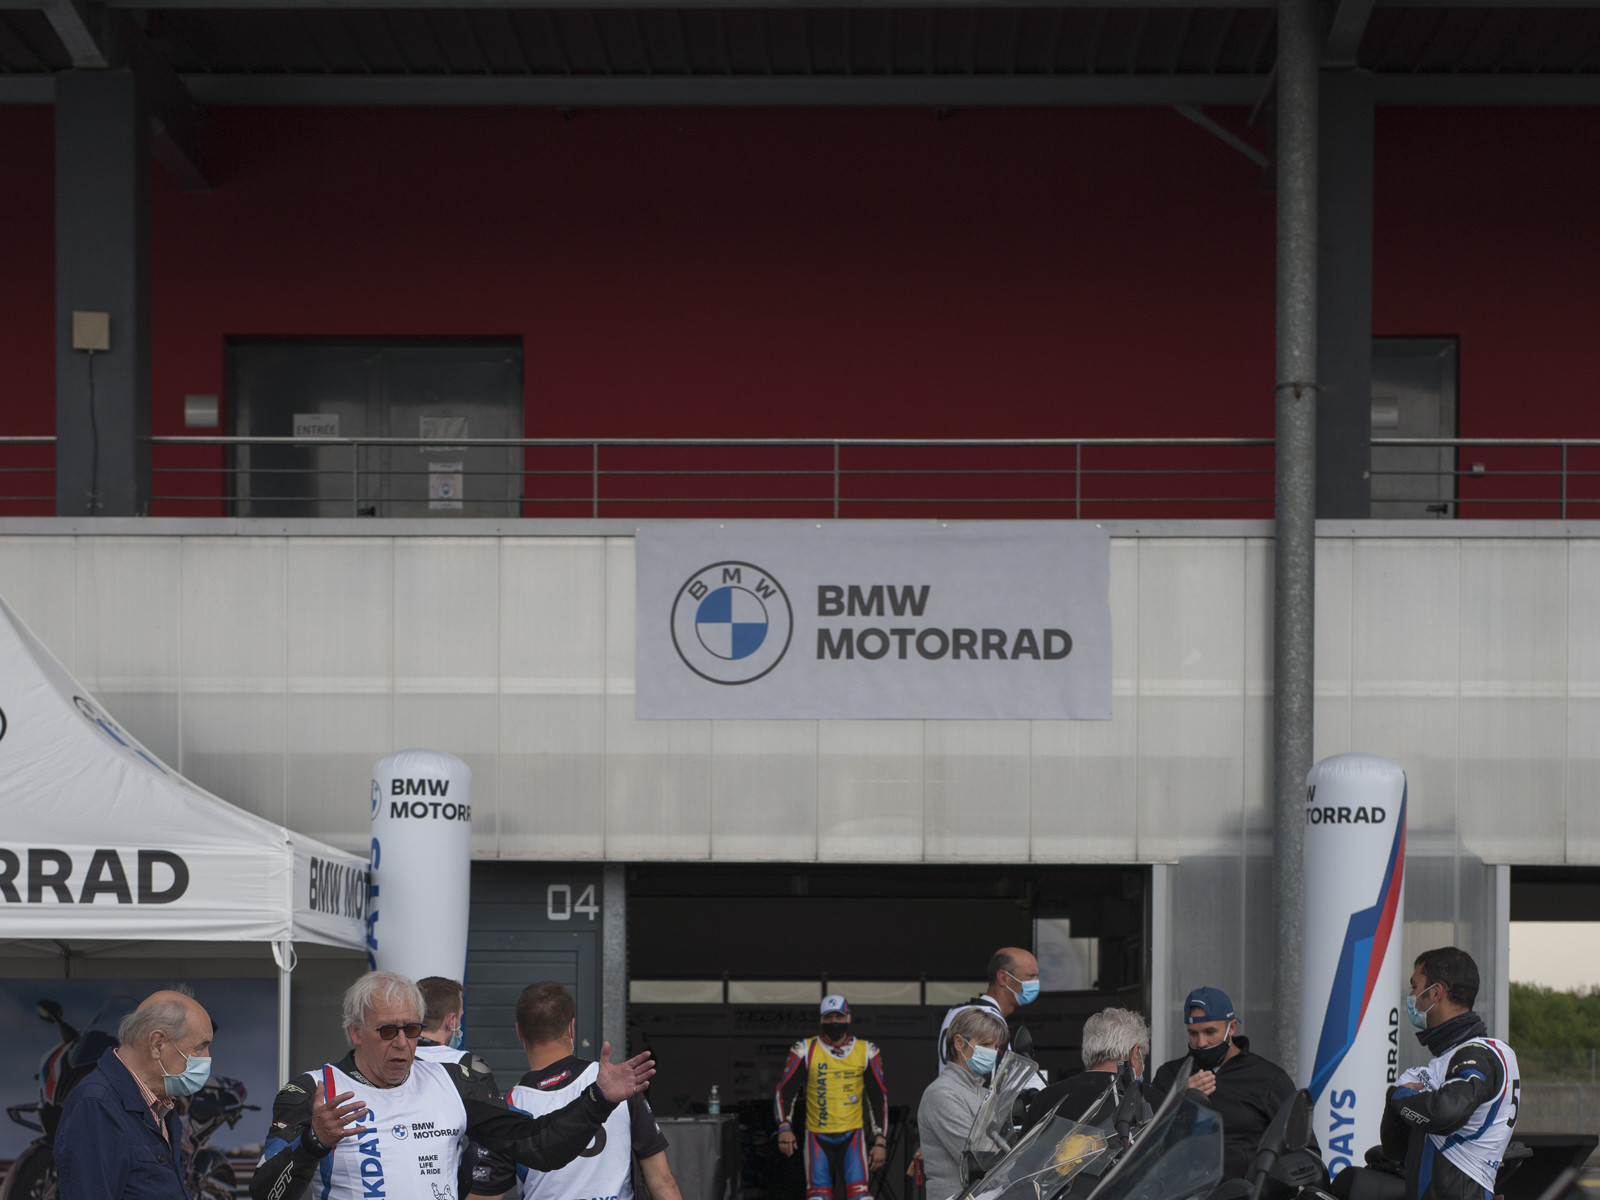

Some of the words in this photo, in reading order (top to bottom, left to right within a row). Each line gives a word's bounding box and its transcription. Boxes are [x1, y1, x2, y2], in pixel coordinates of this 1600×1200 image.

[296, 424, 337, 436] ENTRÉE
[688, 567, 776, 601] BMW
[817, 584, 931, 617] BMW
[816, 628, 1073, 661] MOTORRAD
[391, 778, 450, 797] BMW
[310, 856, 344, 916] BMW
[547, 884, 600, 921] 04
[817, 1062, 828, 1128] TRACKDAYS
[411, 1121, 434, 1131] BMW
[1400, 1106, 1430, 1125] RST
[418, 1154, 438, 1162] MAKE
